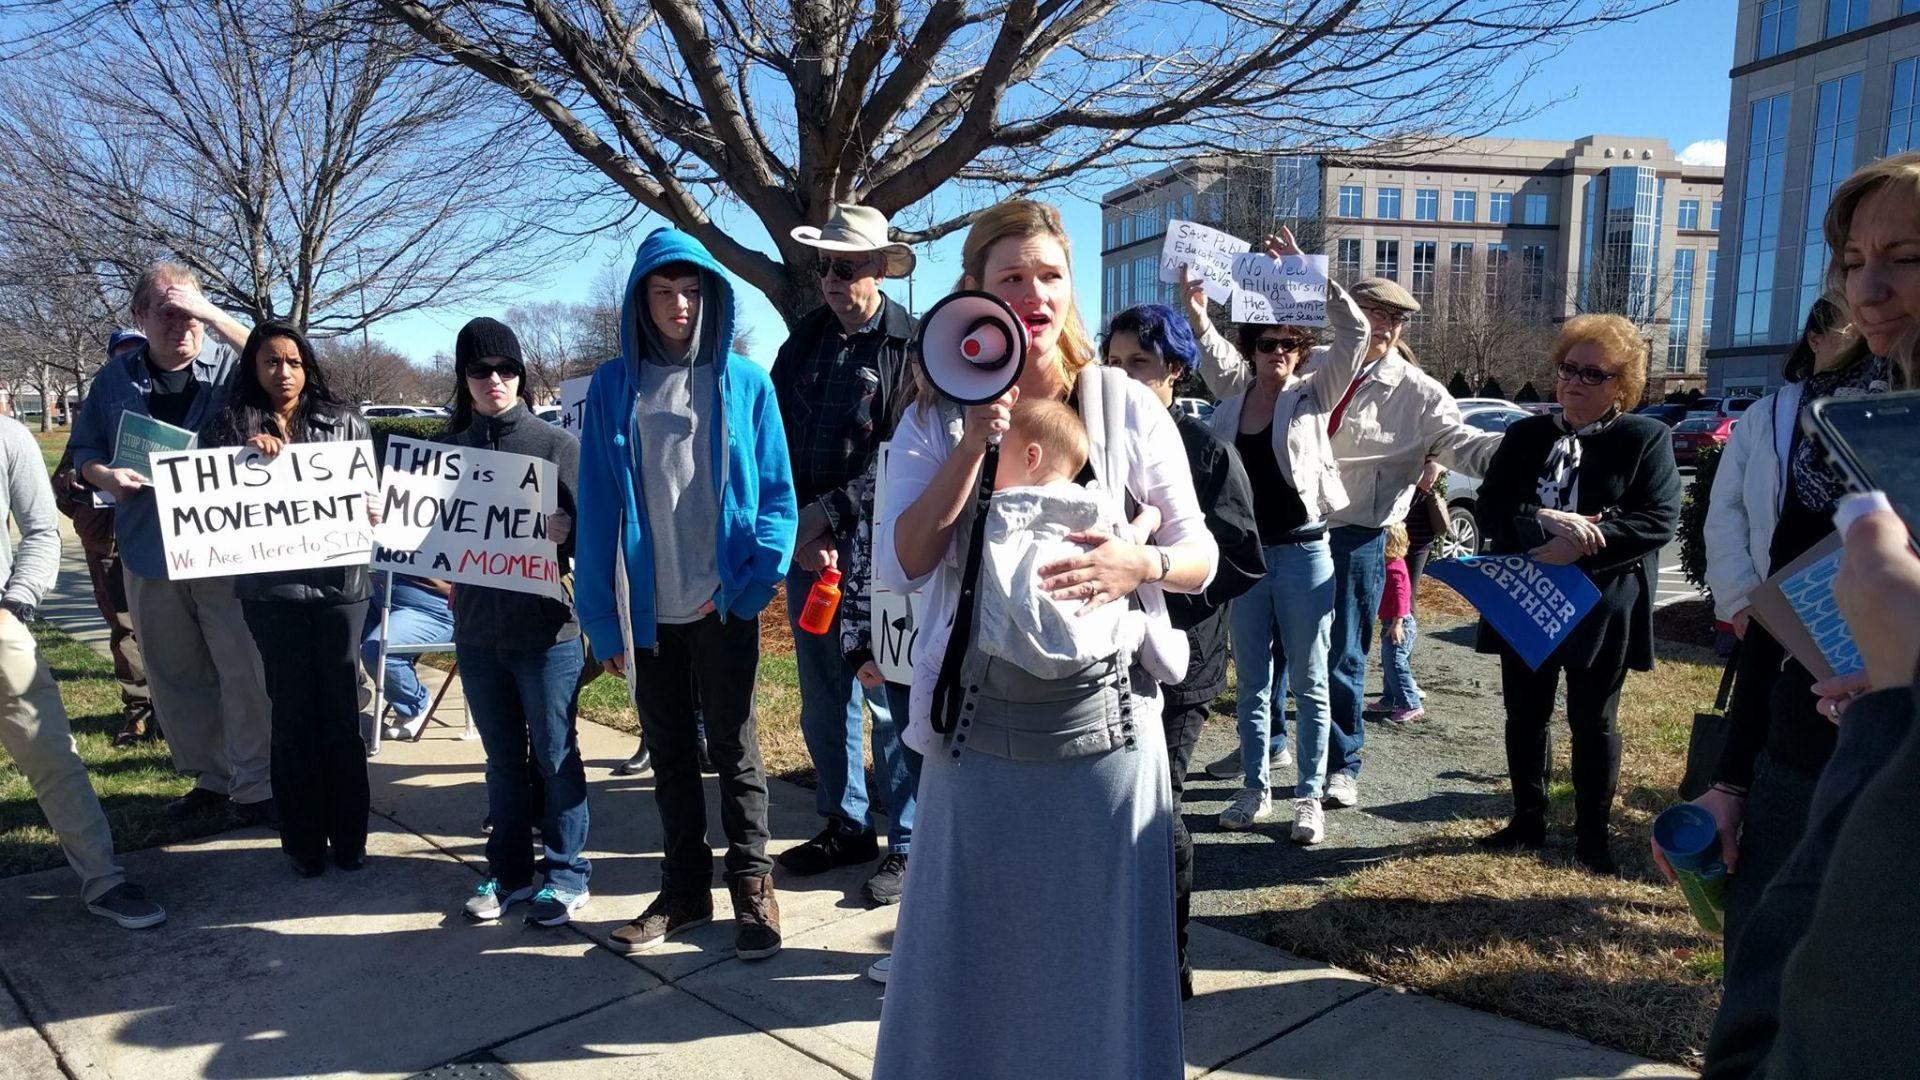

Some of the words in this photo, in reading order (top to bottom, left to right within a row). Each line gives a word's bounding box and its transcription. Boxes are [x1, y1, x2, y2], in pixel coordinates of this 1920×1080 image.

[1214, 234, 1241, 254] Publ
[1191, 259, 1200, 271] to
[1238, 257, 1261, 276] No
[1272, 260, 1308, 276] New
[1242, 277, 1310, 300] Alligators
[1313, 282, 1325, 292] in
[1243, 296, 1266, 310] the
[562, 399, 587, 430] #T
[122, 431, 140, 449] STOP
[157, 453, 271, 494] THIS
[291, 452, 333, 482] IS
[348, 446, 374, 480] A
[390, 442, 461, 481] THIS
[472, 463, 496, 483] is
[519, 462, 540, 493] A
[172, 493, 362, 537] MOVEMENT
[382, 485, 550, 541] MOVEMEN
[251, 541, 295, 561] Here
[296, 535, 321, 554] to
[324, 529, 374, 550] STA
[375, 547, 424, 565] NOT
[432, 552, 452, 571] A
[1497, 556, 1576, 623] ONGER
